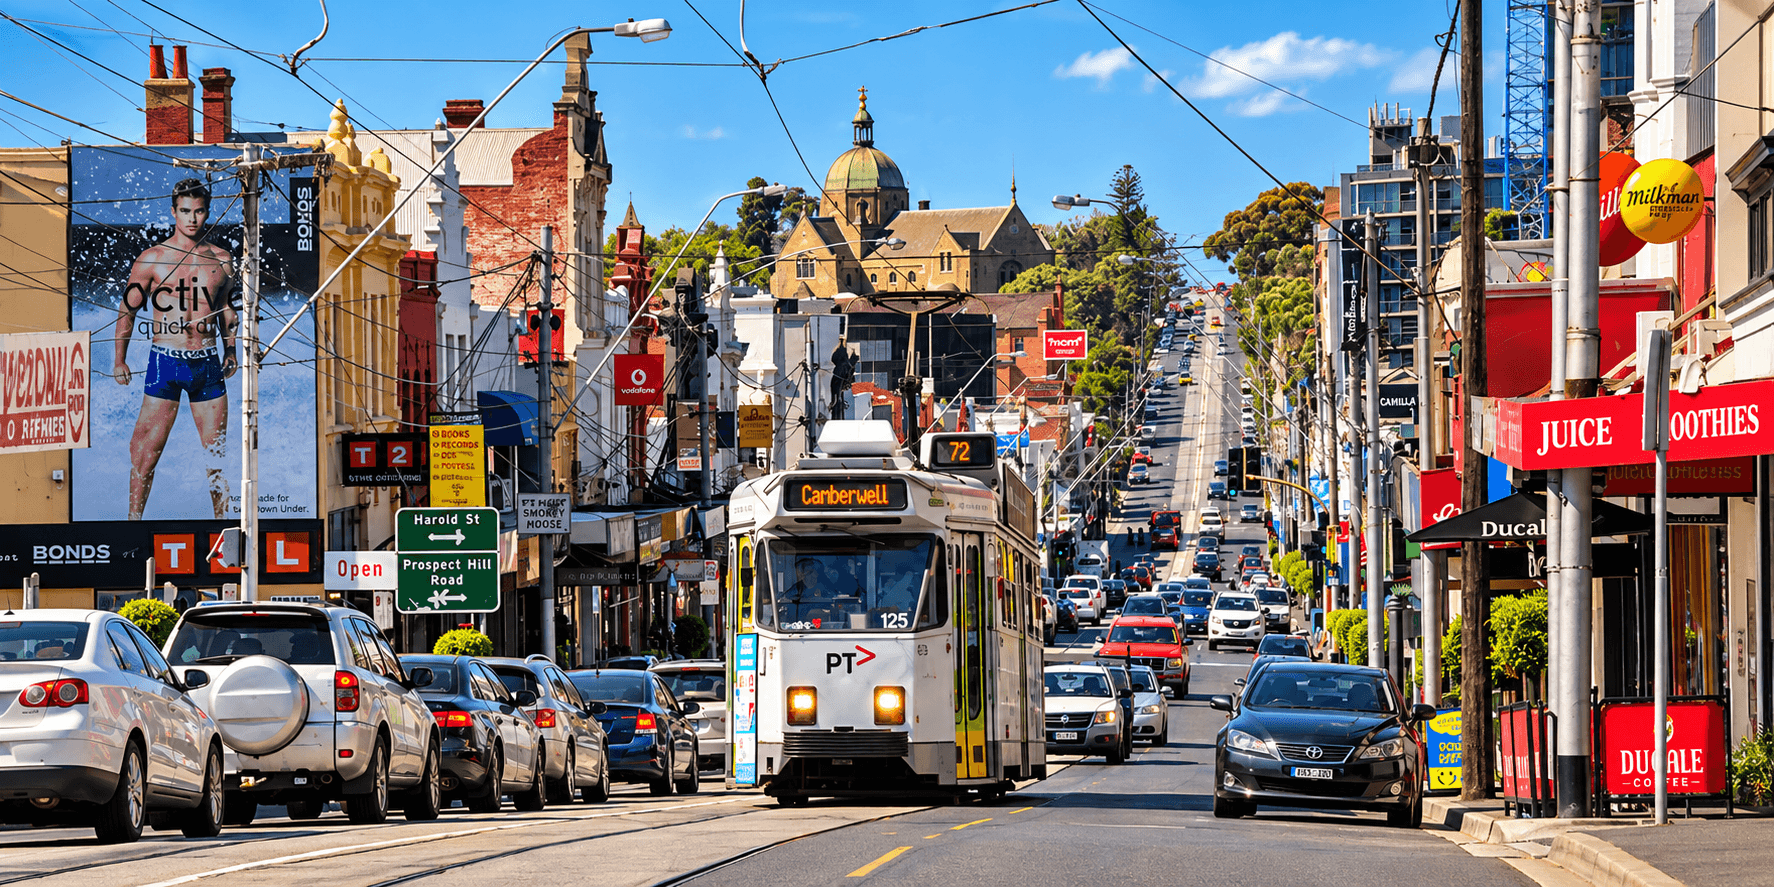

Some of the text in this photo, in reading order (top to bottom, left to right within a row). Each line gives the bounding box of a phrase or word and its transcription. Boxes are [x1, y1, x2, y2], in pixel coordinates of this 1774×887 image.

[1380, 397, 1416, 406] CAMILLA
[1537, 416, 1613, 456] JUICE
[1642, 404, 1760, 444] OOTHIES
[949, 441, 970, 461] 72
[277, 494, 289, 502] for
[801, 484, 889, 505] Camberwell
[280, 505, 309, 513] Under.
[414, 513, 480, 525] Harold St
[1481, 519, 1547, 537] Ducal
[33, 544, 111, 561] BONDS
[338, 560, 382, 581] Open
[403, 558, 491, 573] Prospect Hill
[430, 573, 464, 586] Road
[880, 612, 908, 629] 125
[1633, 778, 1688, 787] COEE
